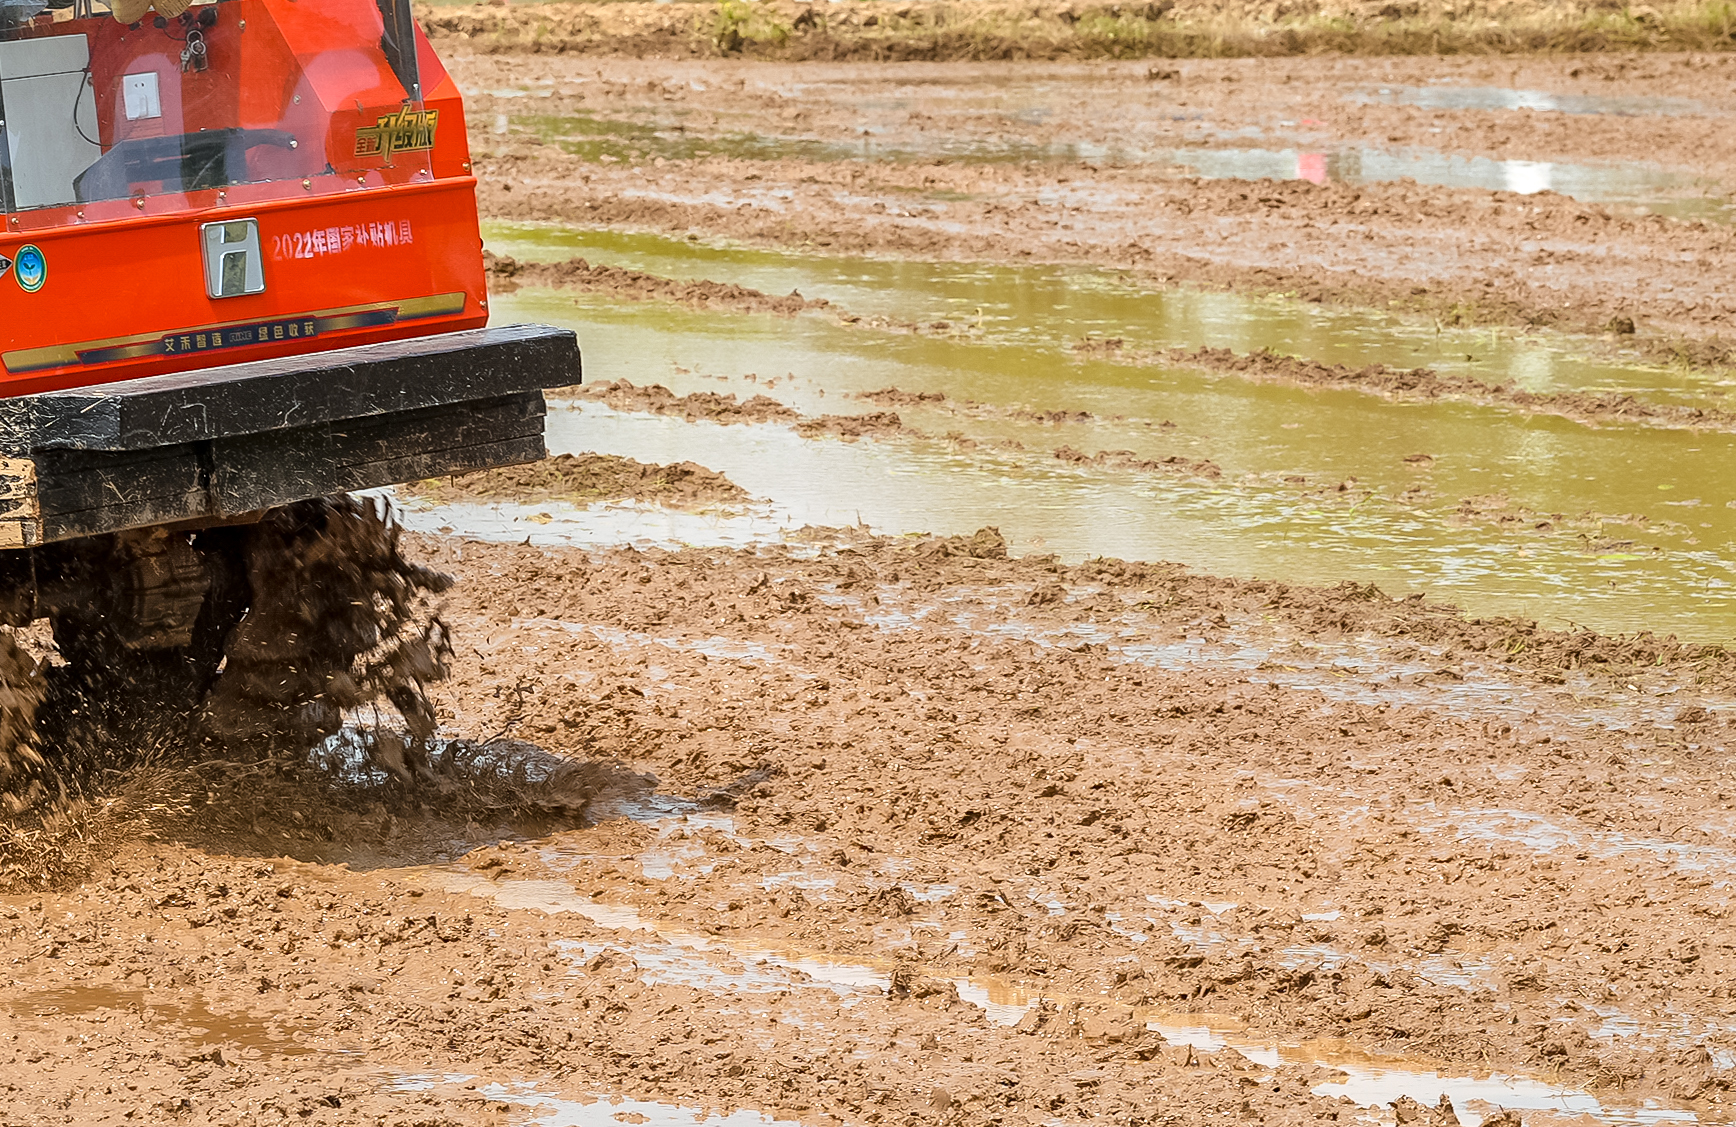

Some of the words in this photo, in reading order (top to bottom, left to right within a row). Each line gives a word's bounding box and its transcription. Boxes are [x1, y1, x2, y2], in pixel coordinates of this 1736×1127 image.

[271, 219, 414, 261] 2022年国家补贴机具
[258, 321, 315, 341] 绿色收获
